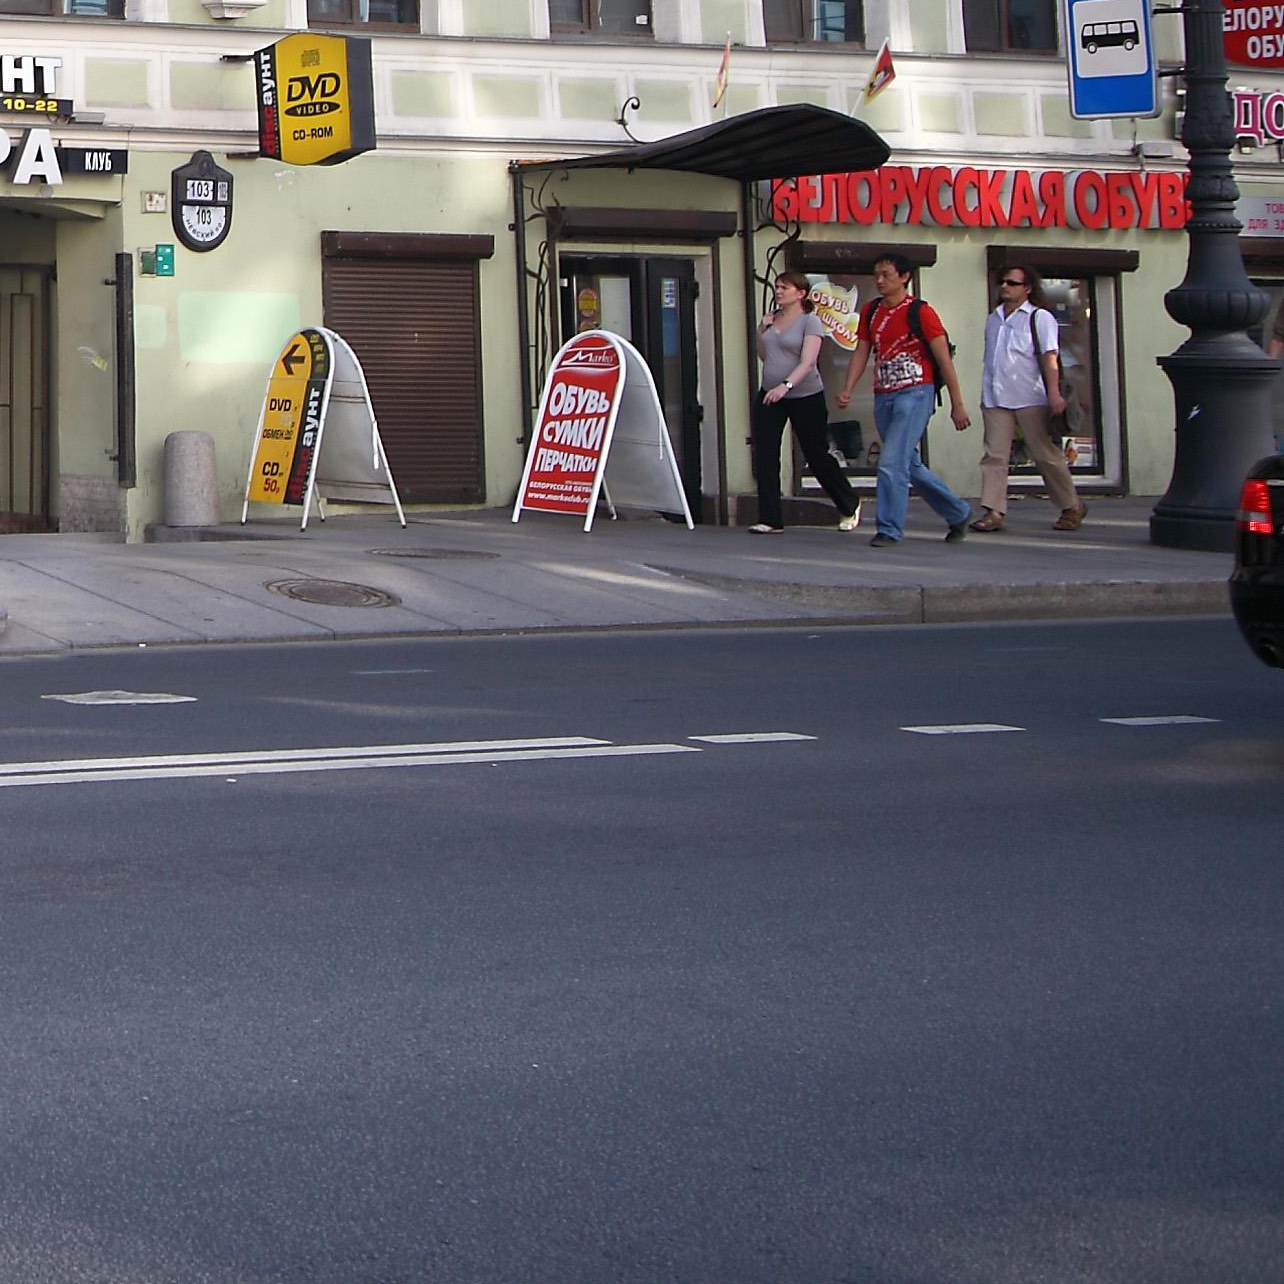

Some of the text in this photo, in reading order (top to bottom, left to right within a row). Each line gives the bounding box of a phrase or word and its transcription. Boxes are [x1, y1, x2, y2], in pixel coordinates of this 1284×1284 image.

[287, 72, 341, 102] DVD
[2, 98, 58, 112] 10-22
[295, 103, 330, 115] VIDEO
[292, 126, 333, 141] CD-ROM
[84, 151, 112, 172] КЛУБ
[190, 181, 210, 198] 103
[770, 165, 1064, 228] БЕЛОРУССКАЯ
[196, 209, 212, 225] 103
[186, 219, 214, 238] НЕВСКИЙ
[811, 288, 849, 314] ОБУВЬ
[822, 313, 858, 344] ШКОЛУ
[269, 398, 292, 412] DVD
[549, 382, 610, 417] ОБУВЬ
[543, 416, 606, 451] СУМКИ
[262, 461, 280, 476] CD
[534, 447, 598, 472] ПЕРЧАТКИ
[529, 481, 572, 492] БЕЛОРУССКАЯ
